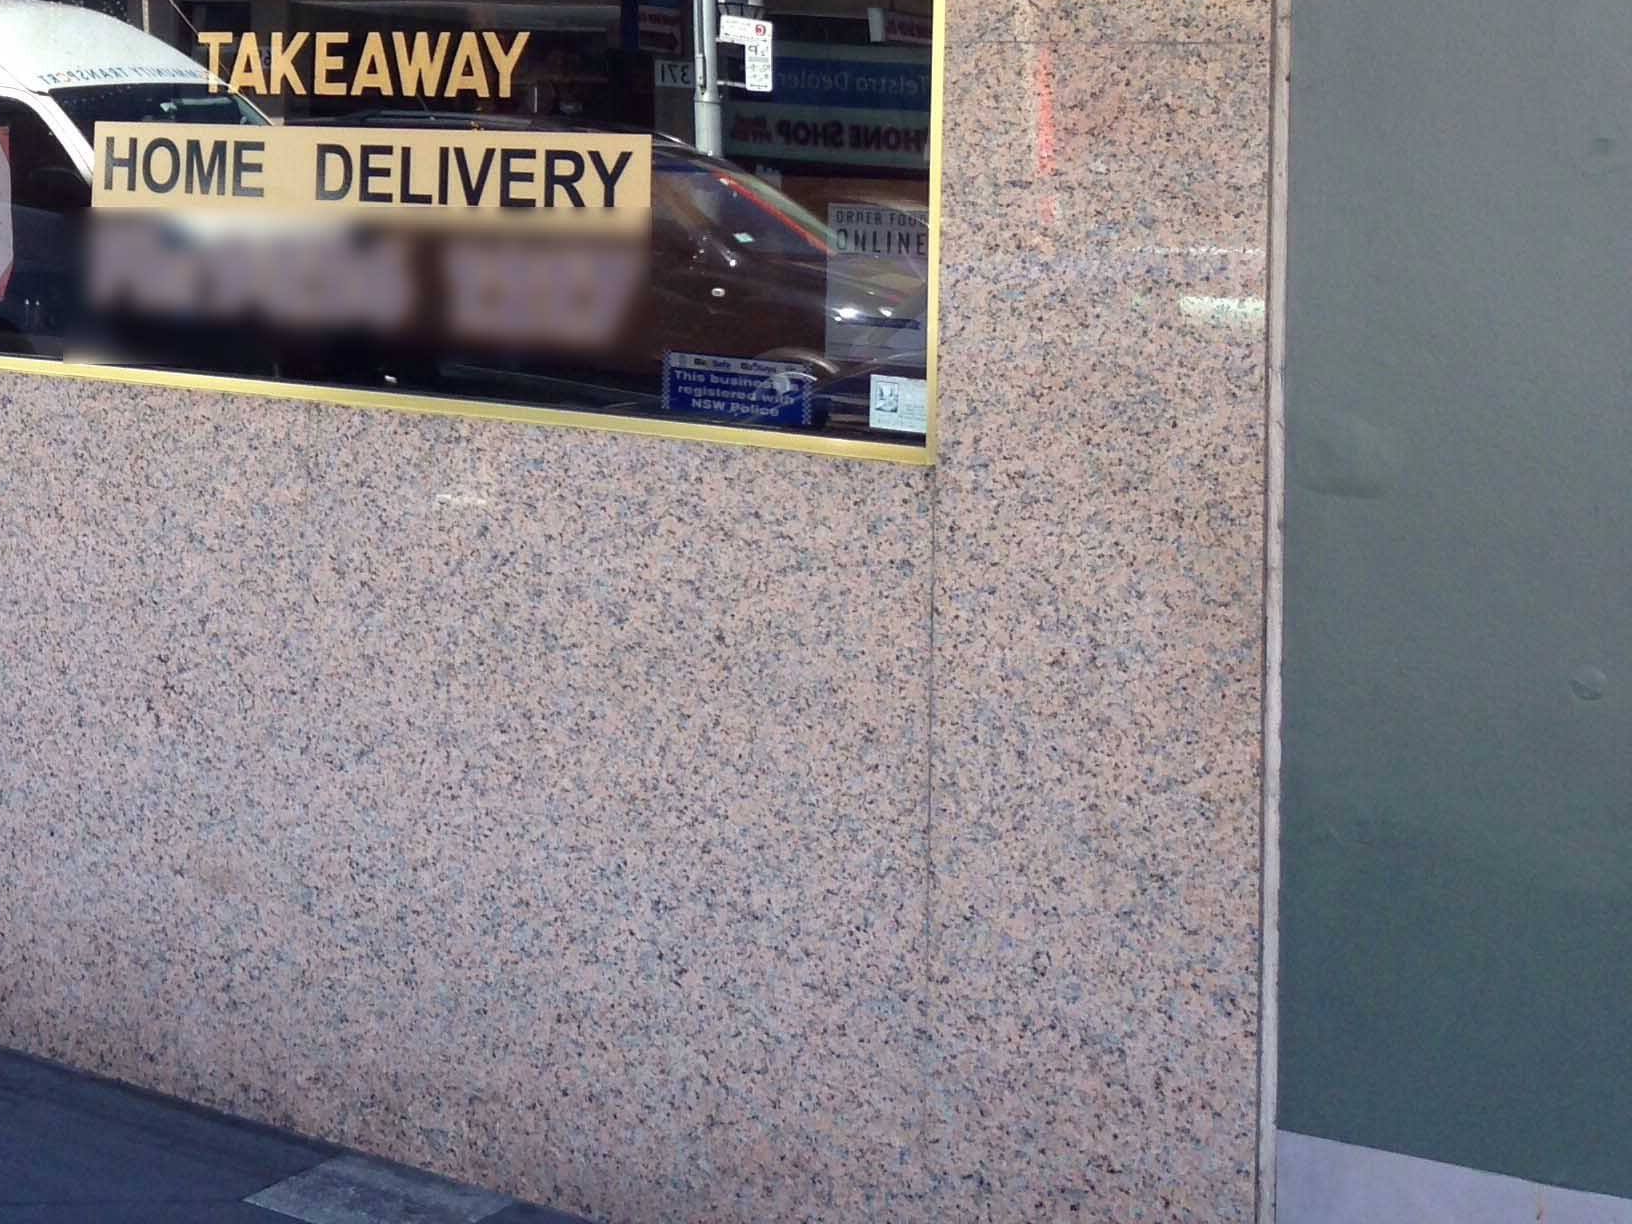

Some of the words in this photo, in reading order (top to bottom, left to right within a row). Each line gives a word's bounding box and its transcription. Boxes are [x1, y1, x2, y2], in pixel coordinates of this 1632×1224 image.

[197, 31, 531, 98] TAKEAWAY
[103, 135, 265, 198] HOME
[315, 142, 634, 208] DELIVERY
[836, 211, 882, 225] ORDER
[836, 228, 927, 256] ONLINE
[675, 370, 706, 383] This
[678, 385, 758, 401] registered
[692, 398, 726, 410] NSW
[729, 402, 780, 417] Police
